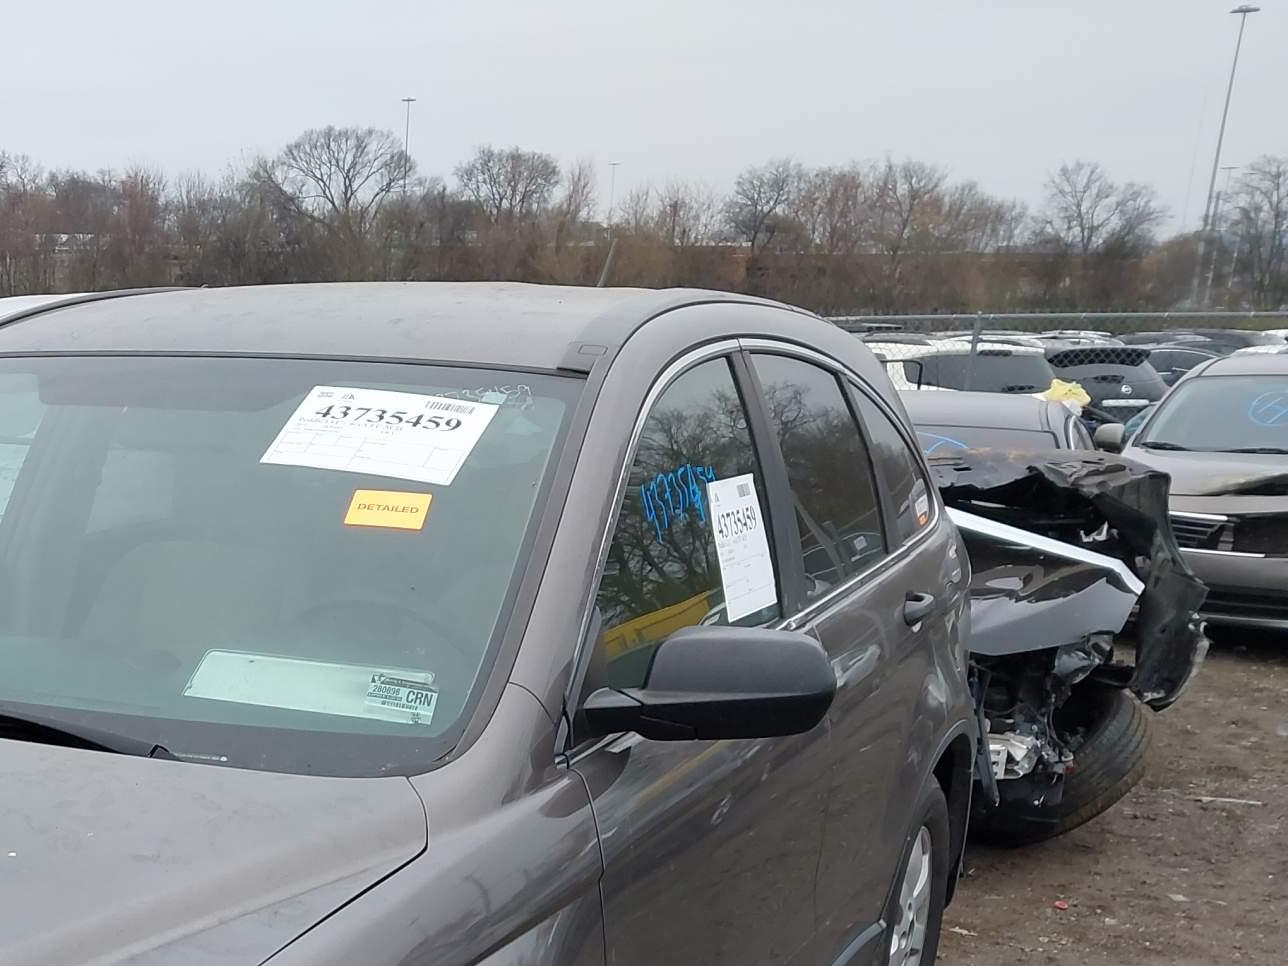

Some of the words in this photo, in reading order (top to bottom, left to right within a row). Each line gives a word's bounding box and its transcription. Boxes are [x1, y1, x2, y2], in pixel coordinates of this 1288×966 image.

[315, 404, 462, 432] 43735459
[357, 503, 419, 514] DETAILED
[717, 505, 757, 538] 43735459
[406, 690, 433, 707] CRN
